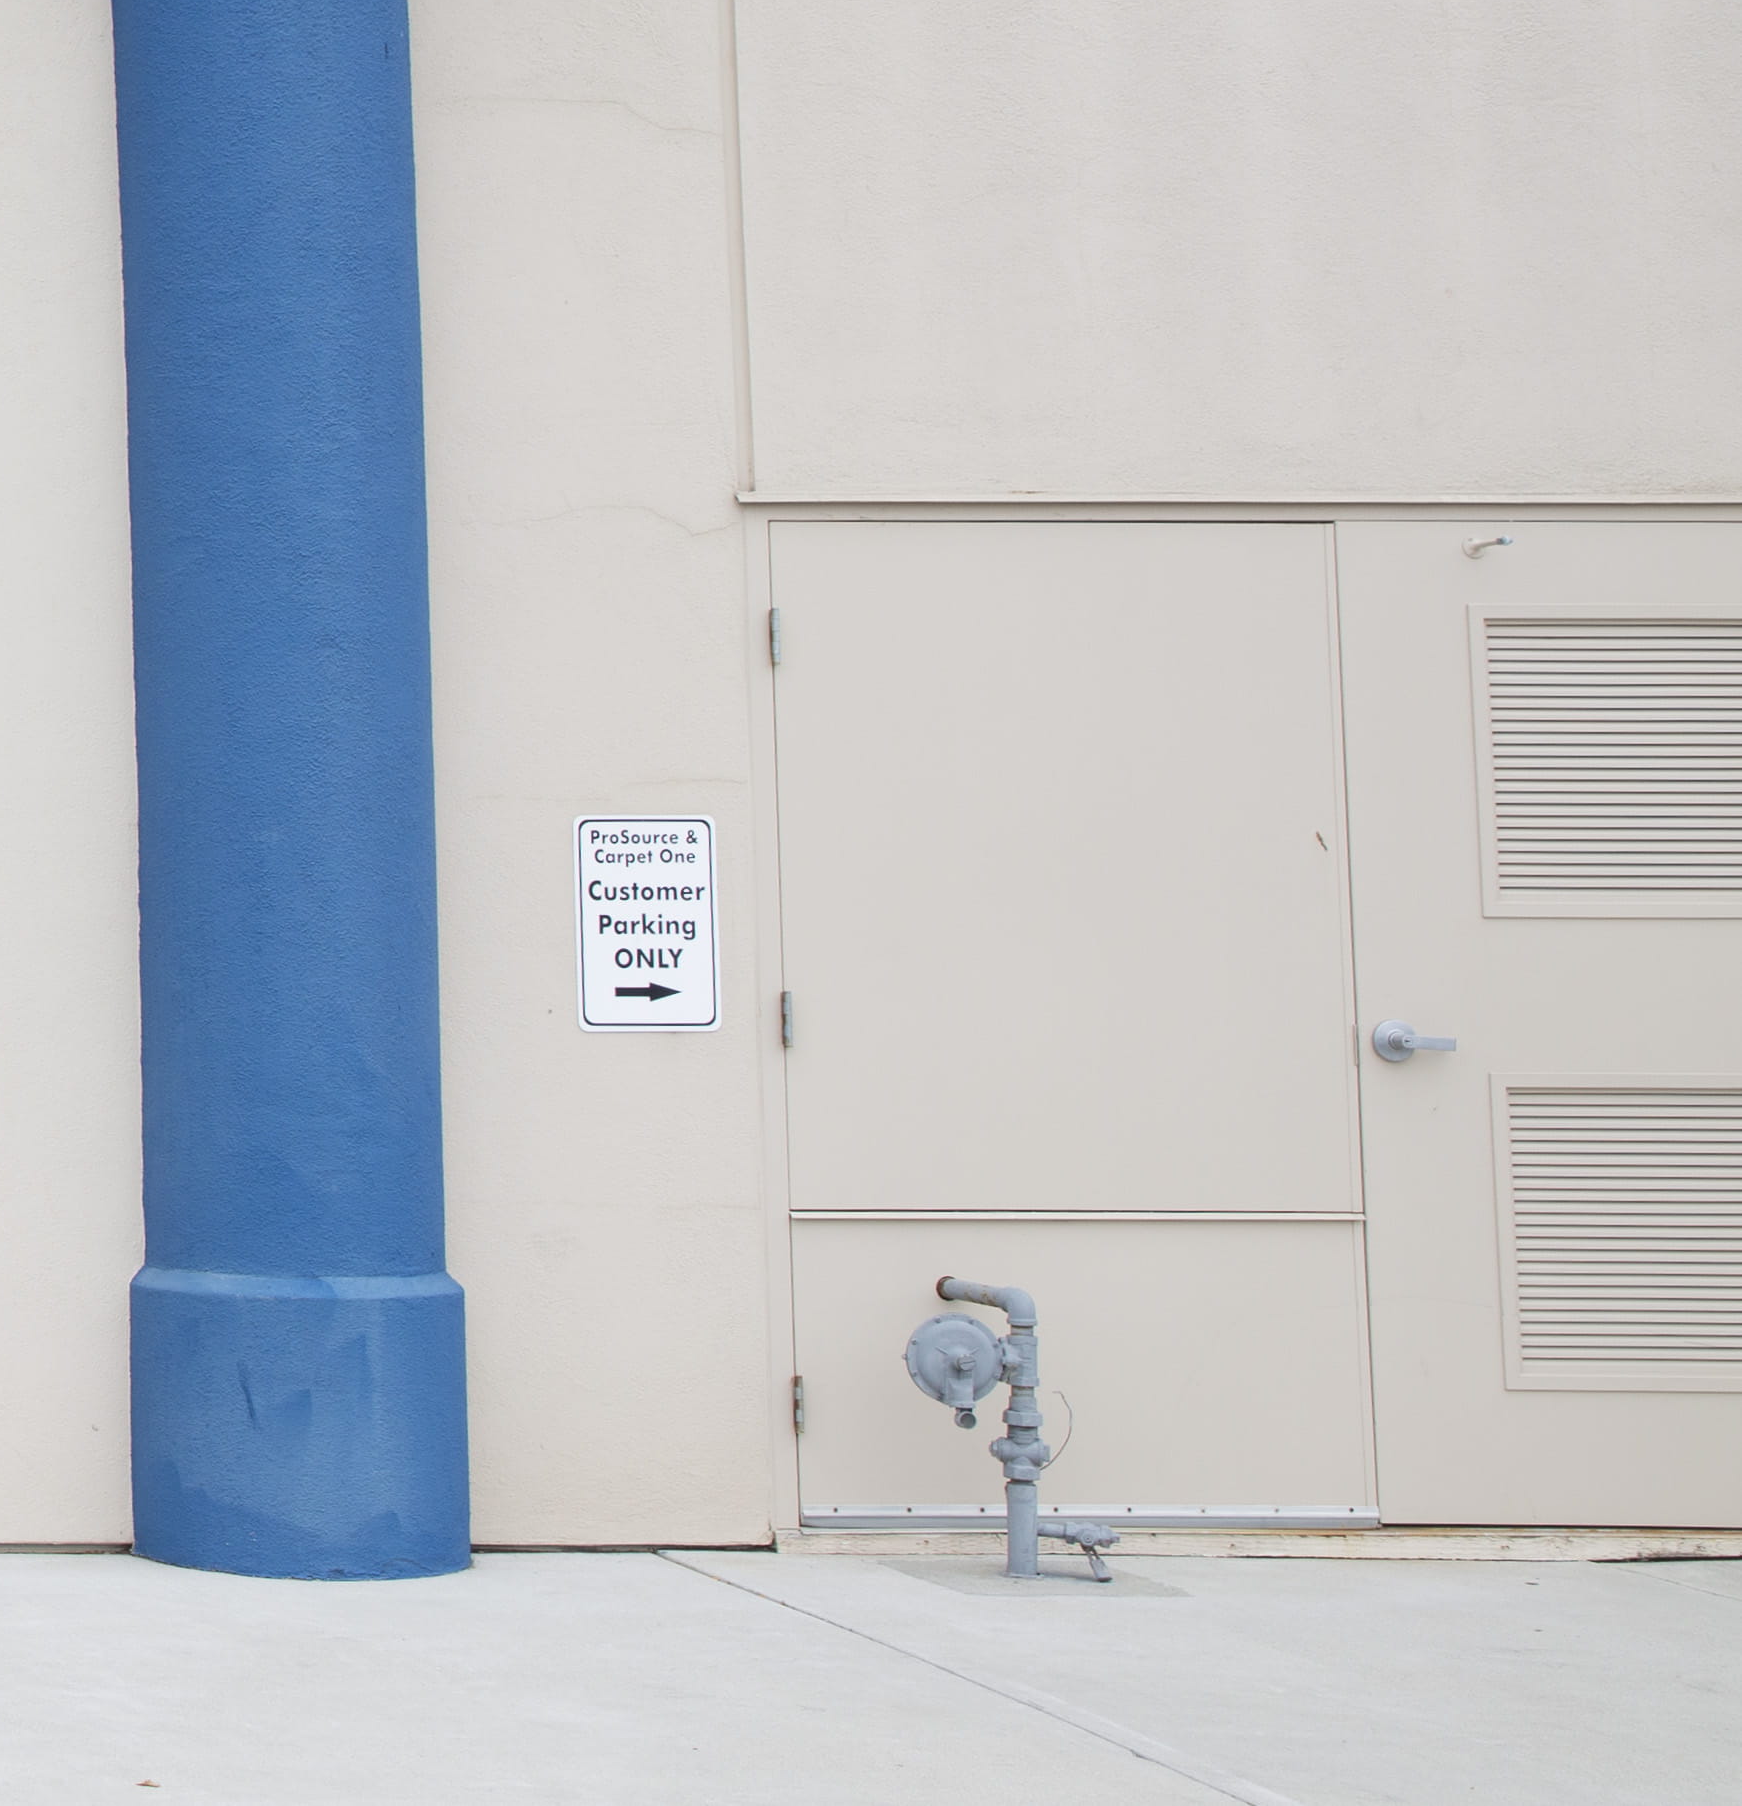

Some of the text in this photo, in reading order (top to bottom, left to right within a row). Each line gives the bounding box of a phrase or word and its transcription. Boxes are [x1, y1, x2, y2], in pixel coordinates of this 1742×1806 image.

[590, 829, 699, 845] ProSource &
[594, 848, 696, 867] Carpet One
[588, 880, 706, 901] Customer
[598, 913, 697, 940] Parking
[614, 948, 684, 969] ONLY
